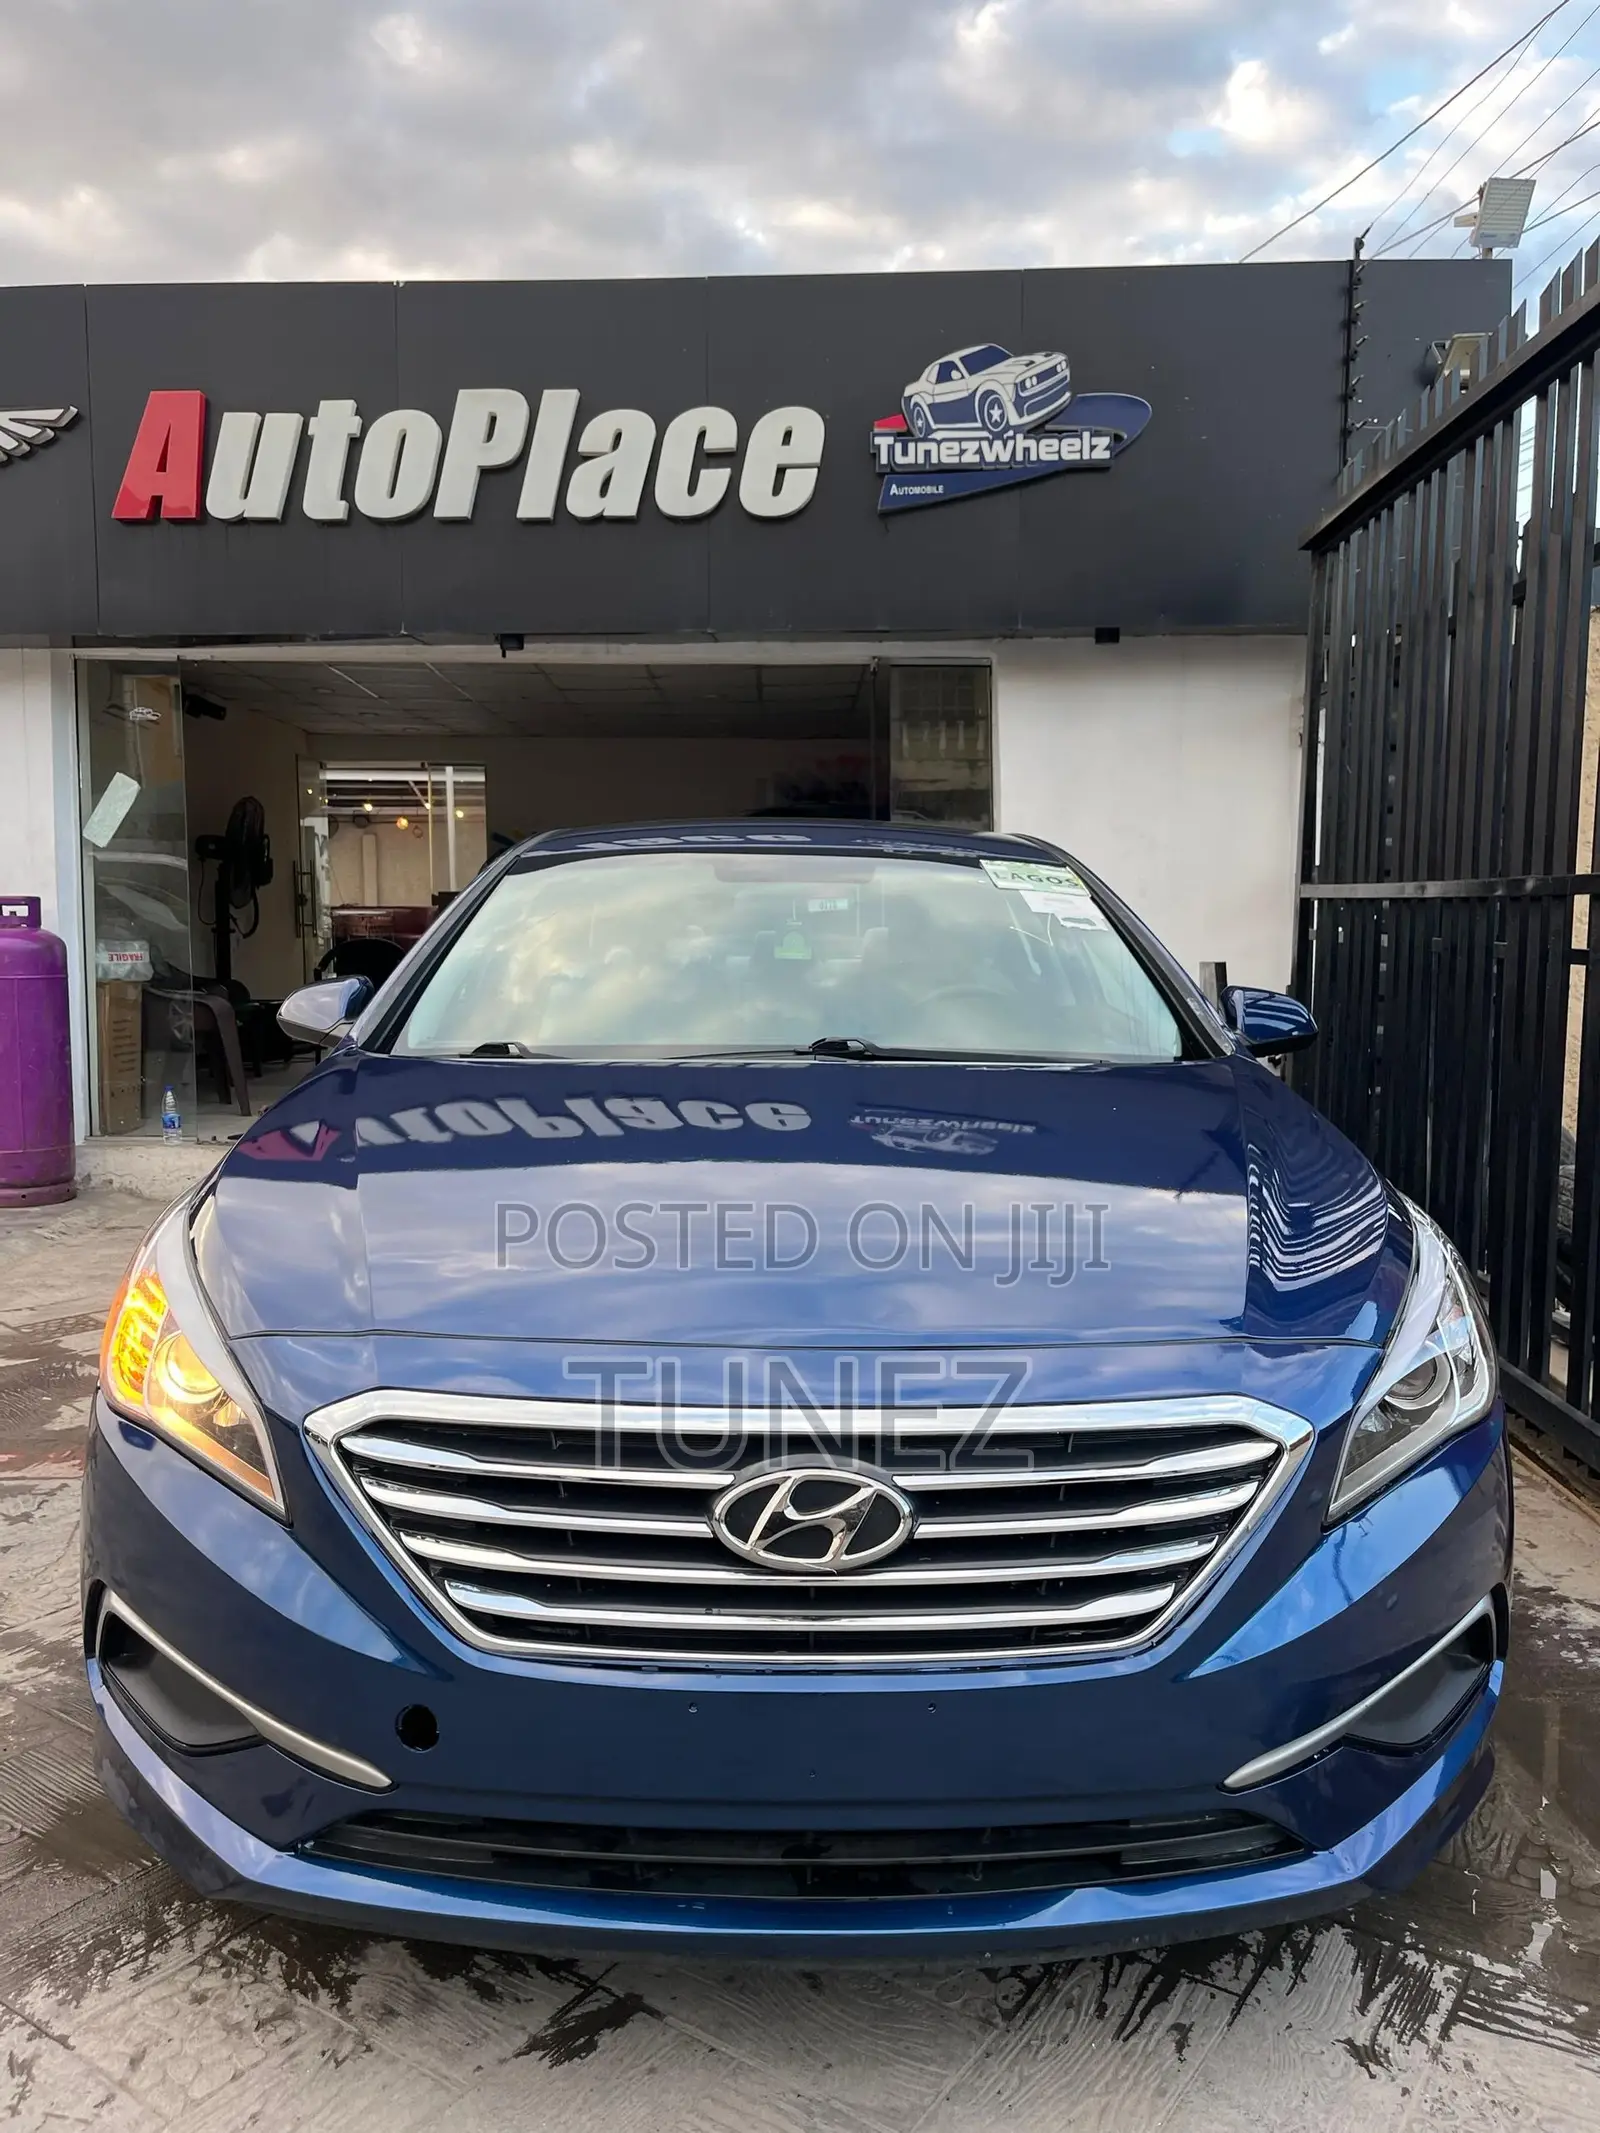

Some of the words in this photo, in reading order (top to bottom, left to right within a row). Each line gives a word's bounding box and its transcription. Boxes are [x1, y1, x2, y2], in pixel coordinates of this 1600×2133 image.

[112, 388, 826, 523] AutoPlace
[873, 431, 1112, 466] Tunezwheelz
[890, 484, 944, 495] AUTOMOBILE
[993, 872, 1080, 888] LAGOS
[107, 952, 143, 962] FRAGILE
